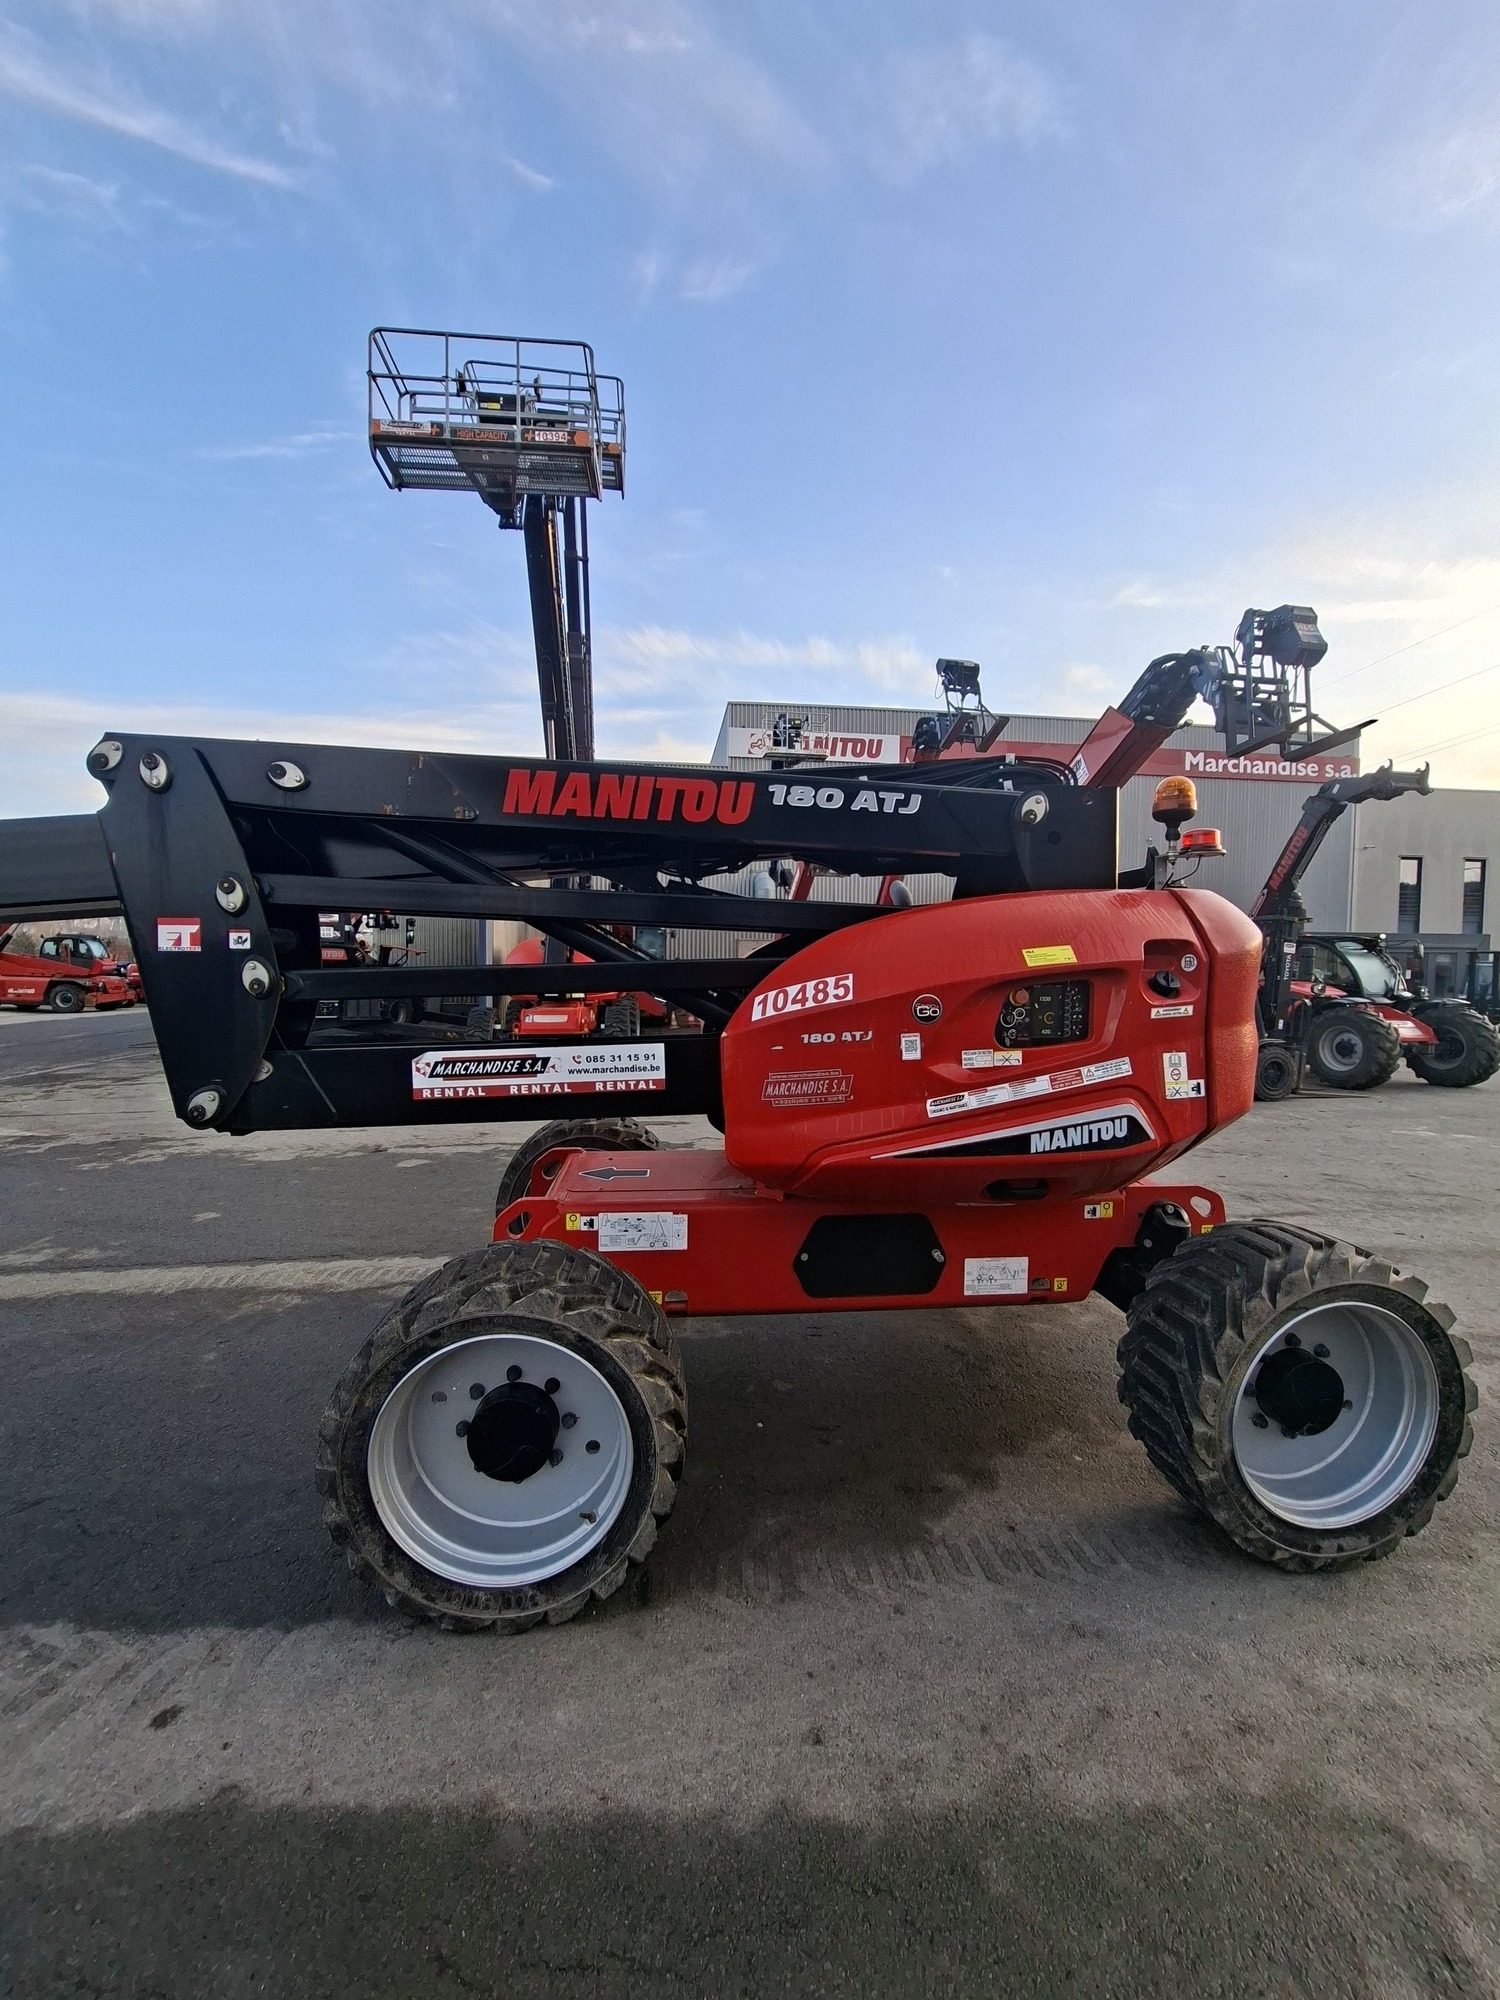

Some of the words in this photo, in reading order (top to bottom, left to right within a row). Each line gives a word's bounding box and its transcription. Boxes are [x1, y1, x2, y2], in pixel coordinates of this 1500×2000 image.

[456, 428, 474, 438] HIGH
[475, 430, 508, 440] CAPACITY
[536, 431, 567, 441] 10394
[1184, 751, 1319, 777] Marchandise
[502, 768, 757, 825] MANITOU
[768, 784, 845, 809] 180
[850, 790, 923, 815] ATJ
[1283, 954, 1292, 980] TOYOTA
[756, 974, 852, 1018] 10485
[801, 1032, 836, 1044] 180
[841, 1030, 873, 1042] ATJ
[585, 1055, 606, 1063] 085
[609, 1054, 622, 1062] 31
[627, 1053, 640, 1061] 15
[643, 1052, 656, 1061] 91
[433, 1060, 521, 1076] MARCHANDISE
[522, 1059, 545, 1073] S.A.
[567, 1063, 661, 1075] www.marchandise.be
[422, 1086, 486, 1098] RENTAL
[509, 1083, 572, 1095] RENTAL
[595, 1080, 657, 1091] RENTAL
[765, 1080, 829, 1096] MARCHANDISE
[831, 1079, 848, 1093] S.A.
[1030, 1117, 1128, 1154] MANITOU
